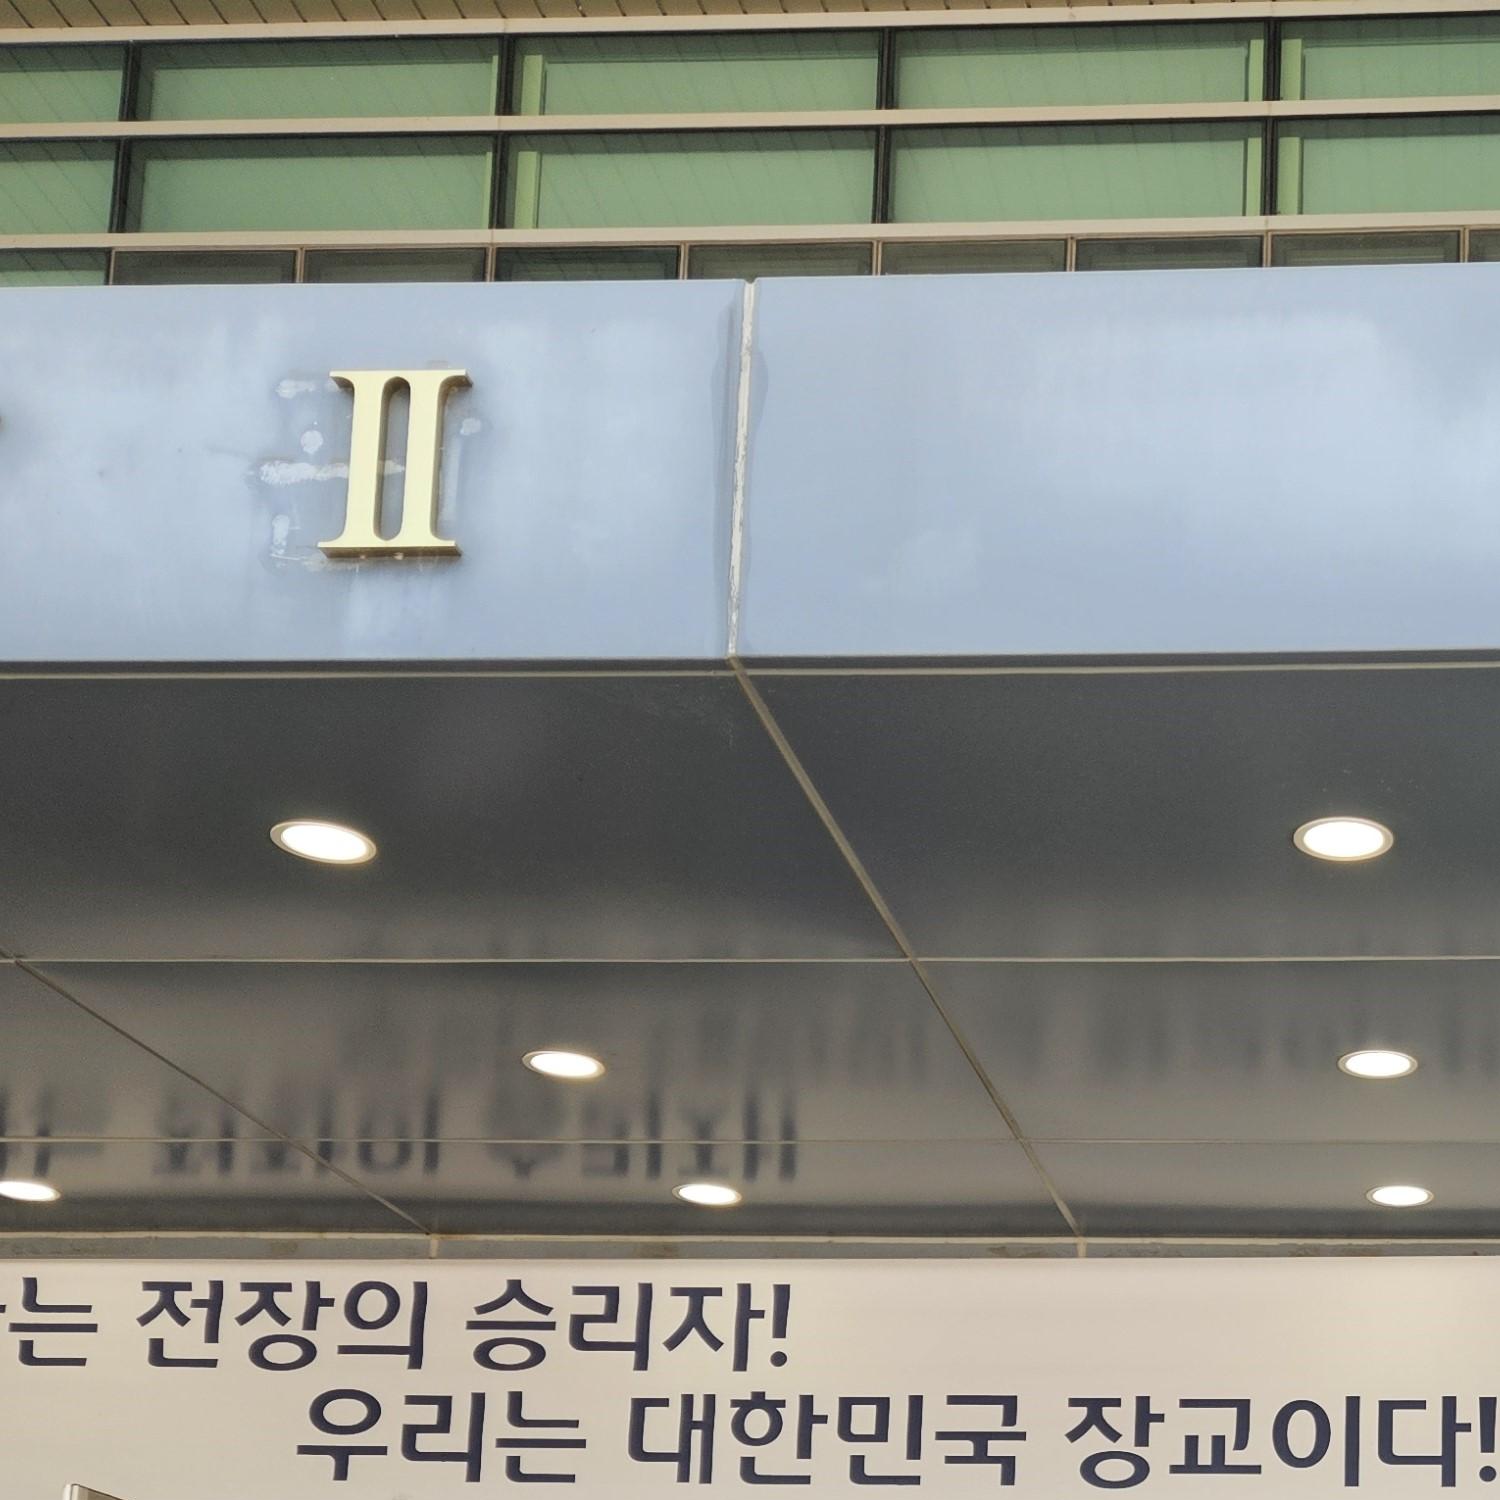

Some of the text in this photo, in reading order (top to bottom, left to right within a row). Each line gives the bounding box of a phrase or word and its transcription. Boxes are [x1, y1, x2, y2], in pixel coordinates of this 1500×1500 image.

[0, 1278, 791, 1372] 는 전장의 승리자!
[297, 1388, 1498, 1489] 우리는 대한민국 장교이다!
